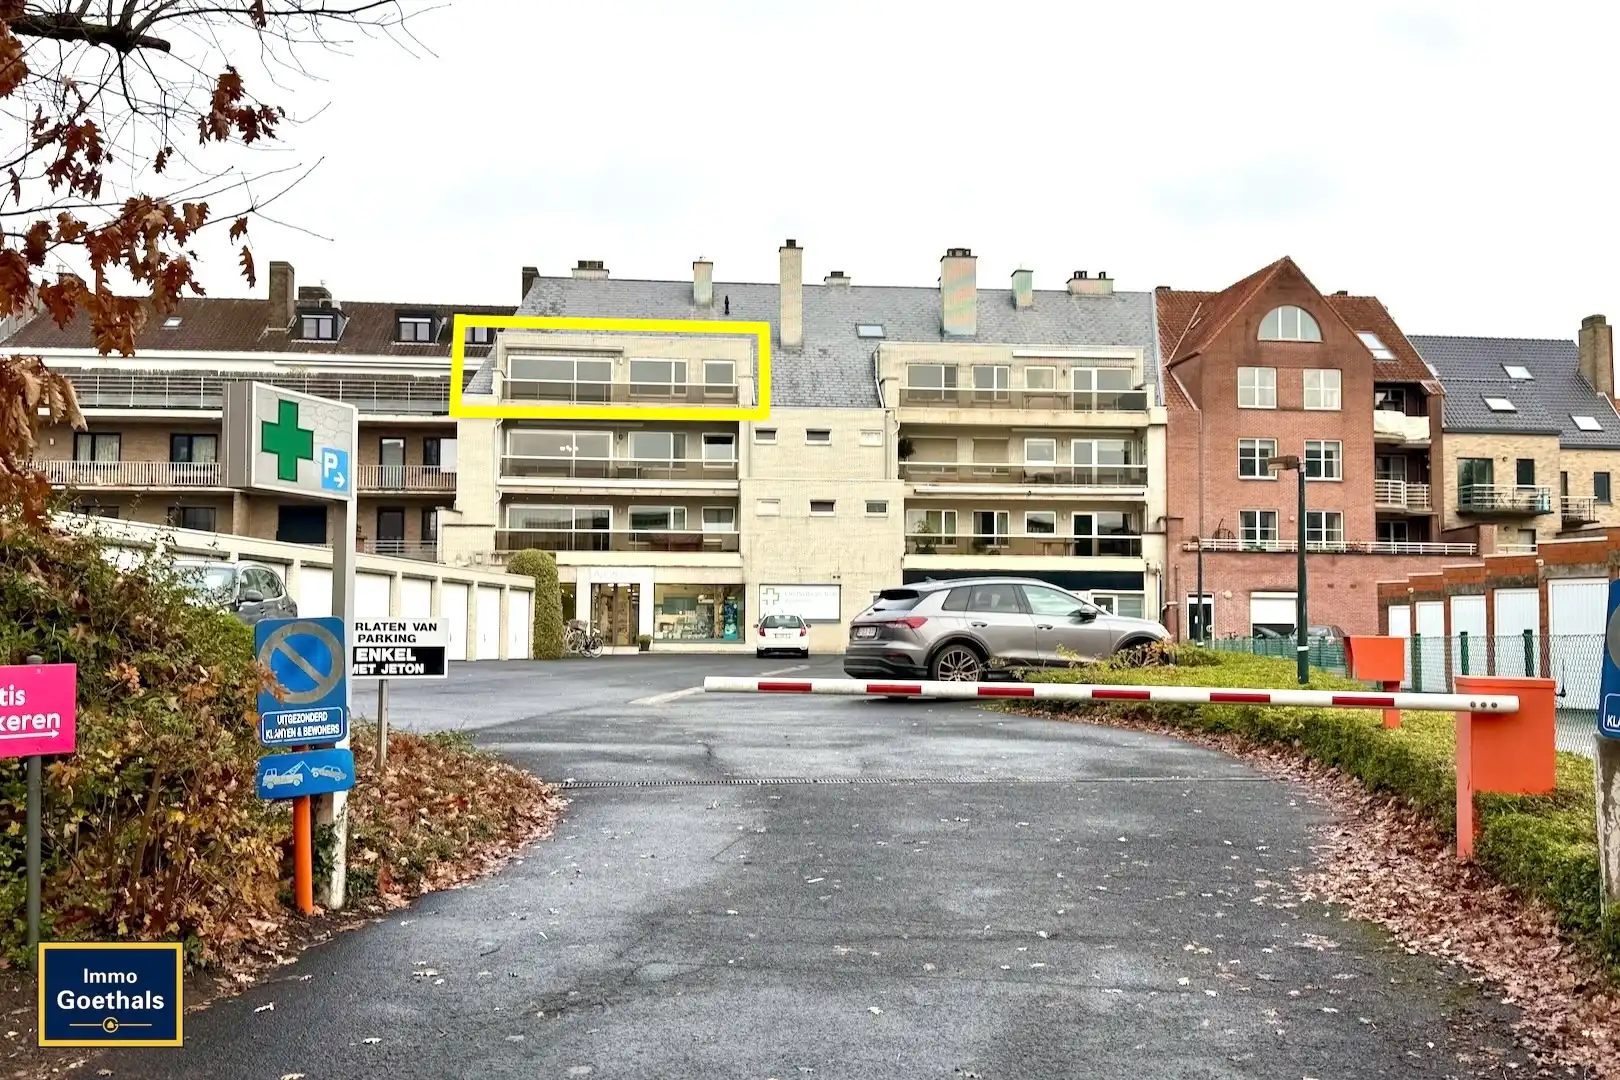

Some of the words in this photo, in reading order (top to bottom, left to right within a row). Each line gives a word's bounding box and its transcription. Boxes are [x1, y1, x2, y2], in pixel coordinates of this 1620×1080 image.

[324, 451, 338, 478] P
[413, 622, 437, 632] VAN
[358, 634, 416, 643] PARKING
[356, 647, 416, 662] ENKEL
[381, 663, 424, 674] JETON
[277, 711, 328, 725] UITGEZONDERD
[297, 727, 302, 737] &
[303, 724, 340, 736] BEWONERS
